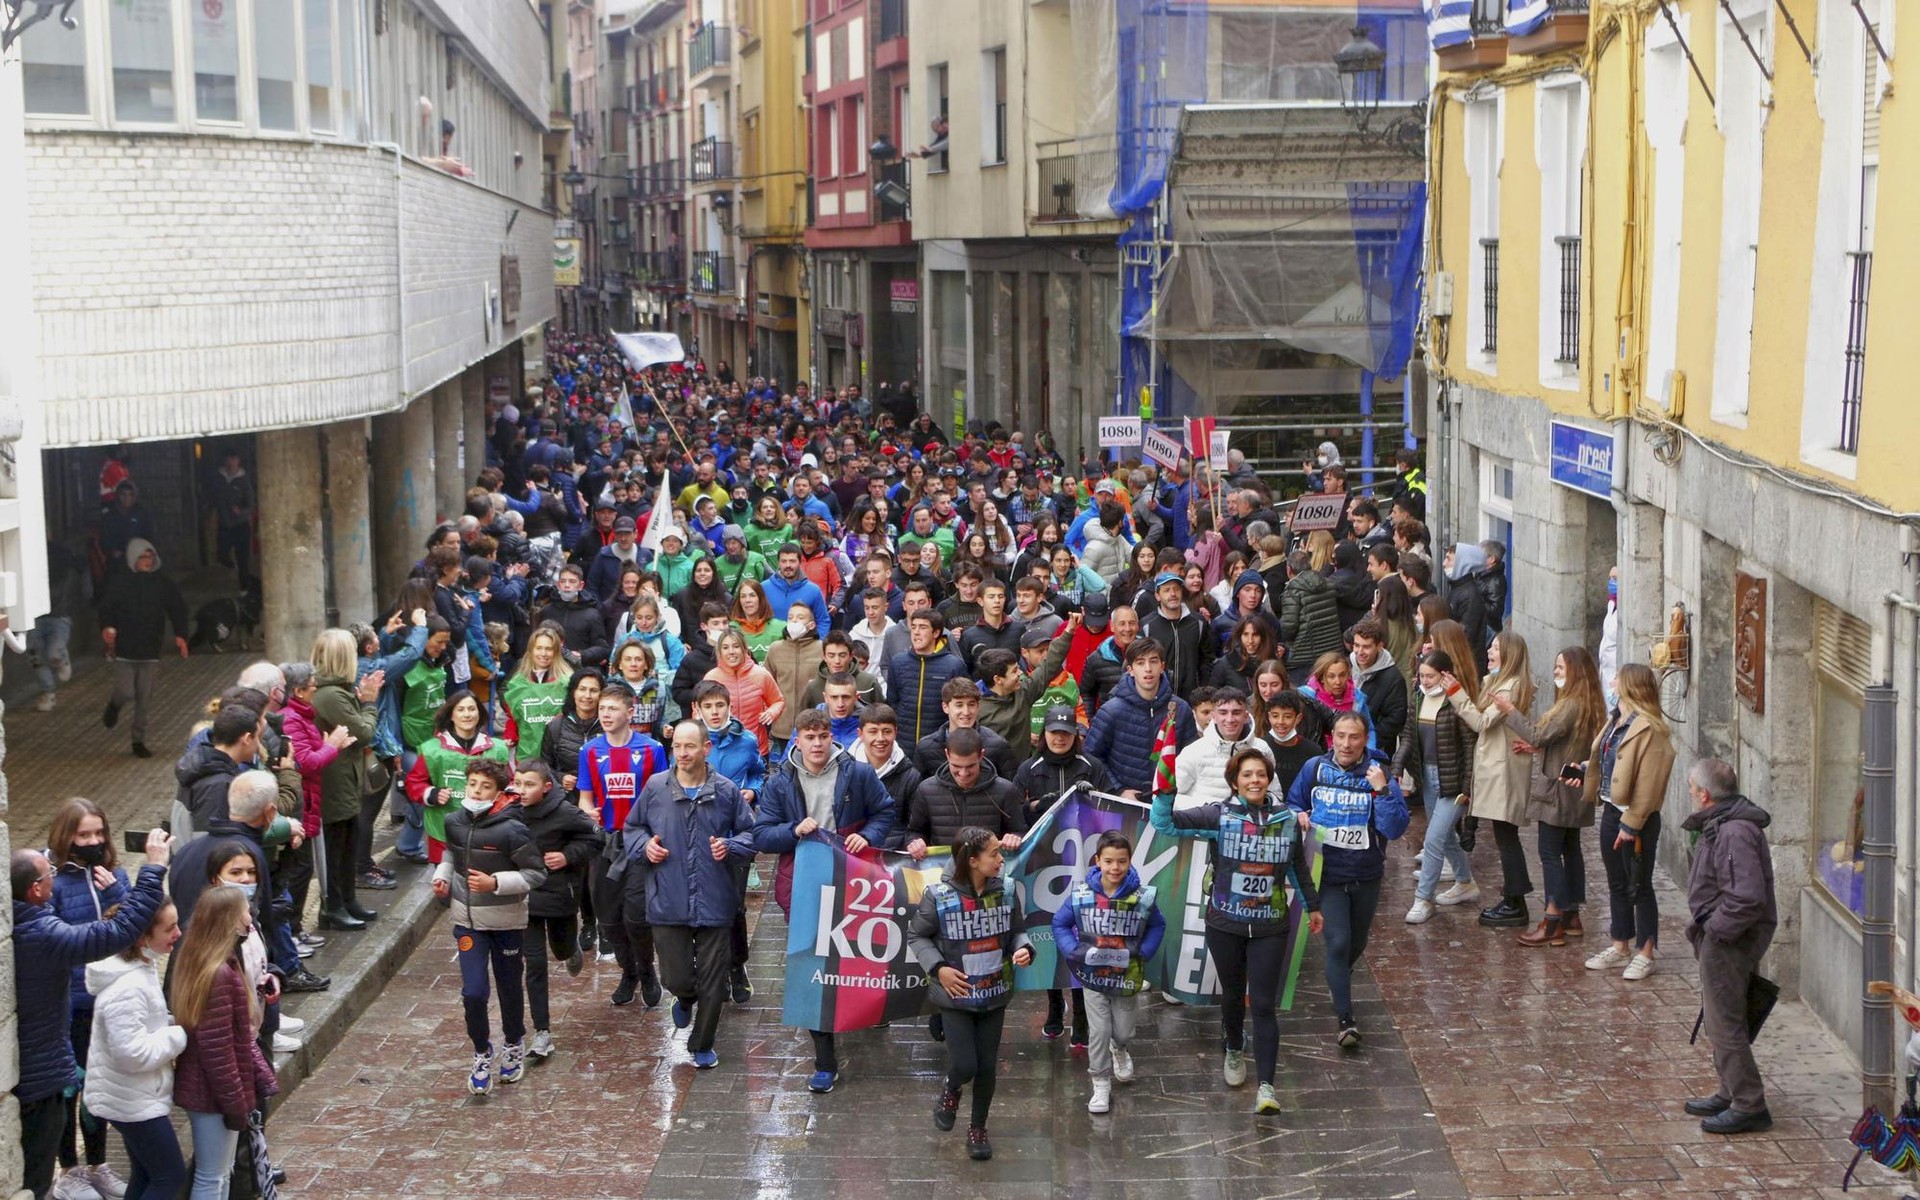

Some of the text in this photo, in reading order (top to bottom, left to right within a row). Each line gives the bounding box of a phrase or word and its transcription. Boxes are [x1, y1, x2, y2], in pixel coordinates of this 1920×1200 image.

[1334, 828, 1362, 845] 1722
[1242, 877, 1267, 894] 220
[811, 969, 900, 990] Amurriotik
